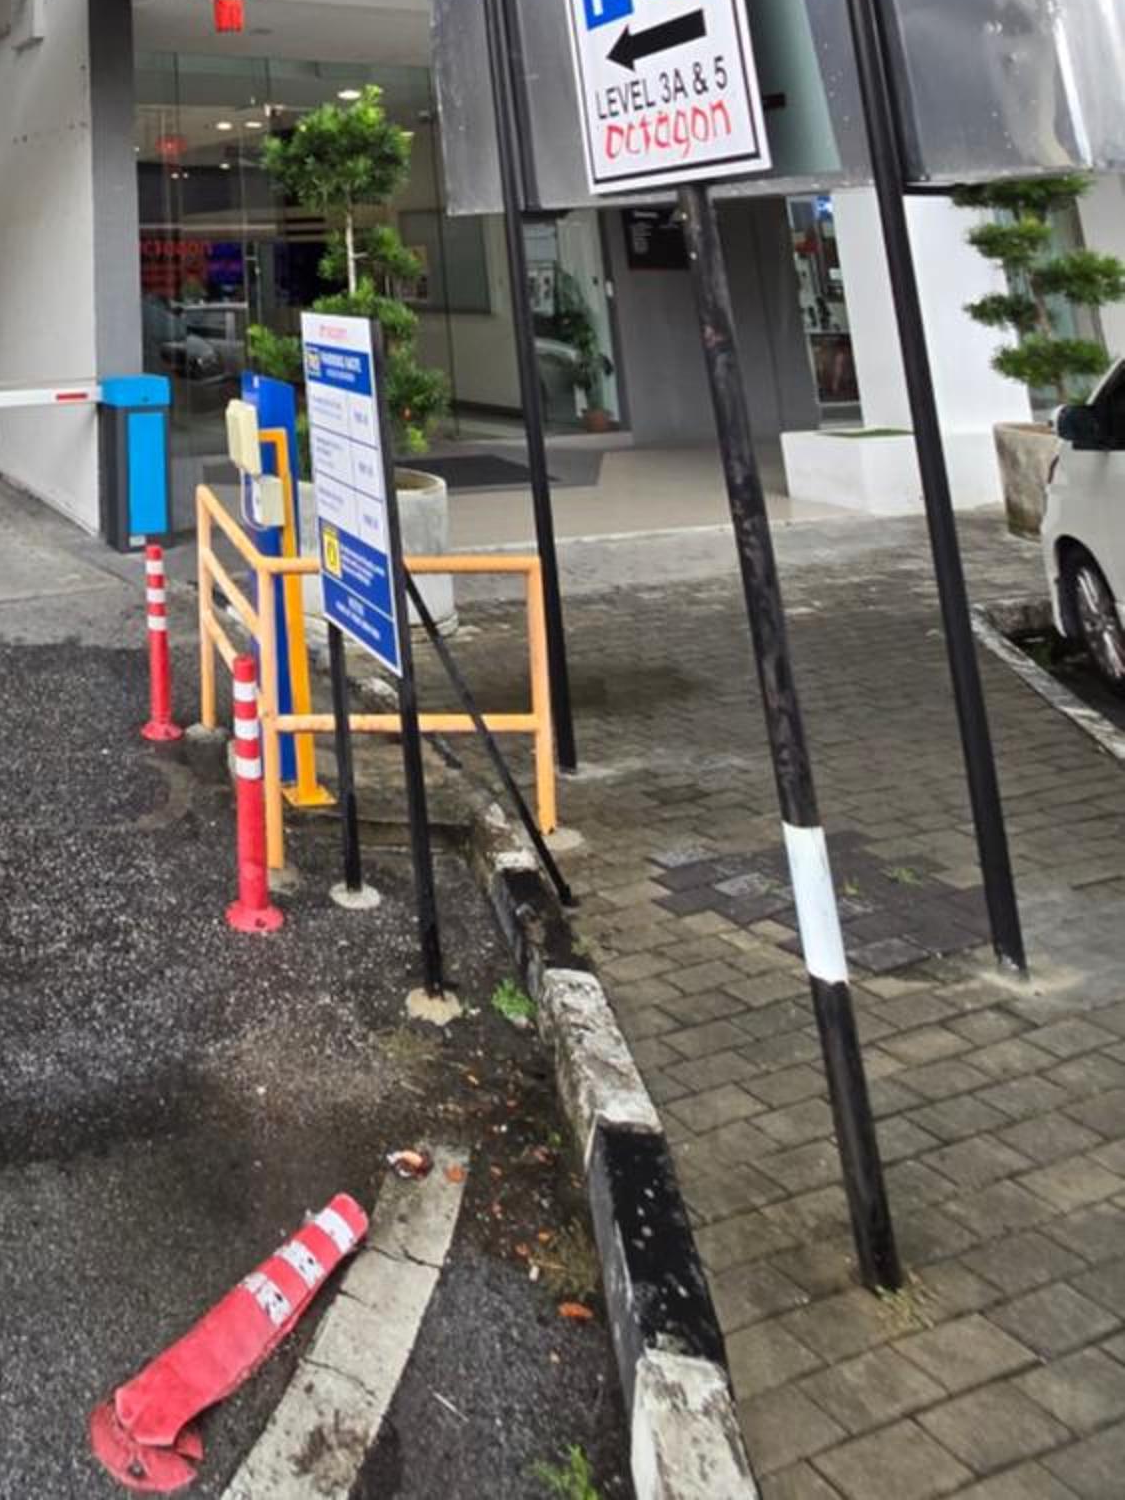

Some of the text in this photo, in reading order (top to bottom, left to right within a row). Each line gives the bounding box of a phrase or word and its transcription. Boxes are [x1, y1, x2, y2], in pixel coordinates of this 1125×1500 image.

[595, 56, 728, 121] LEVEL 3A & 5
